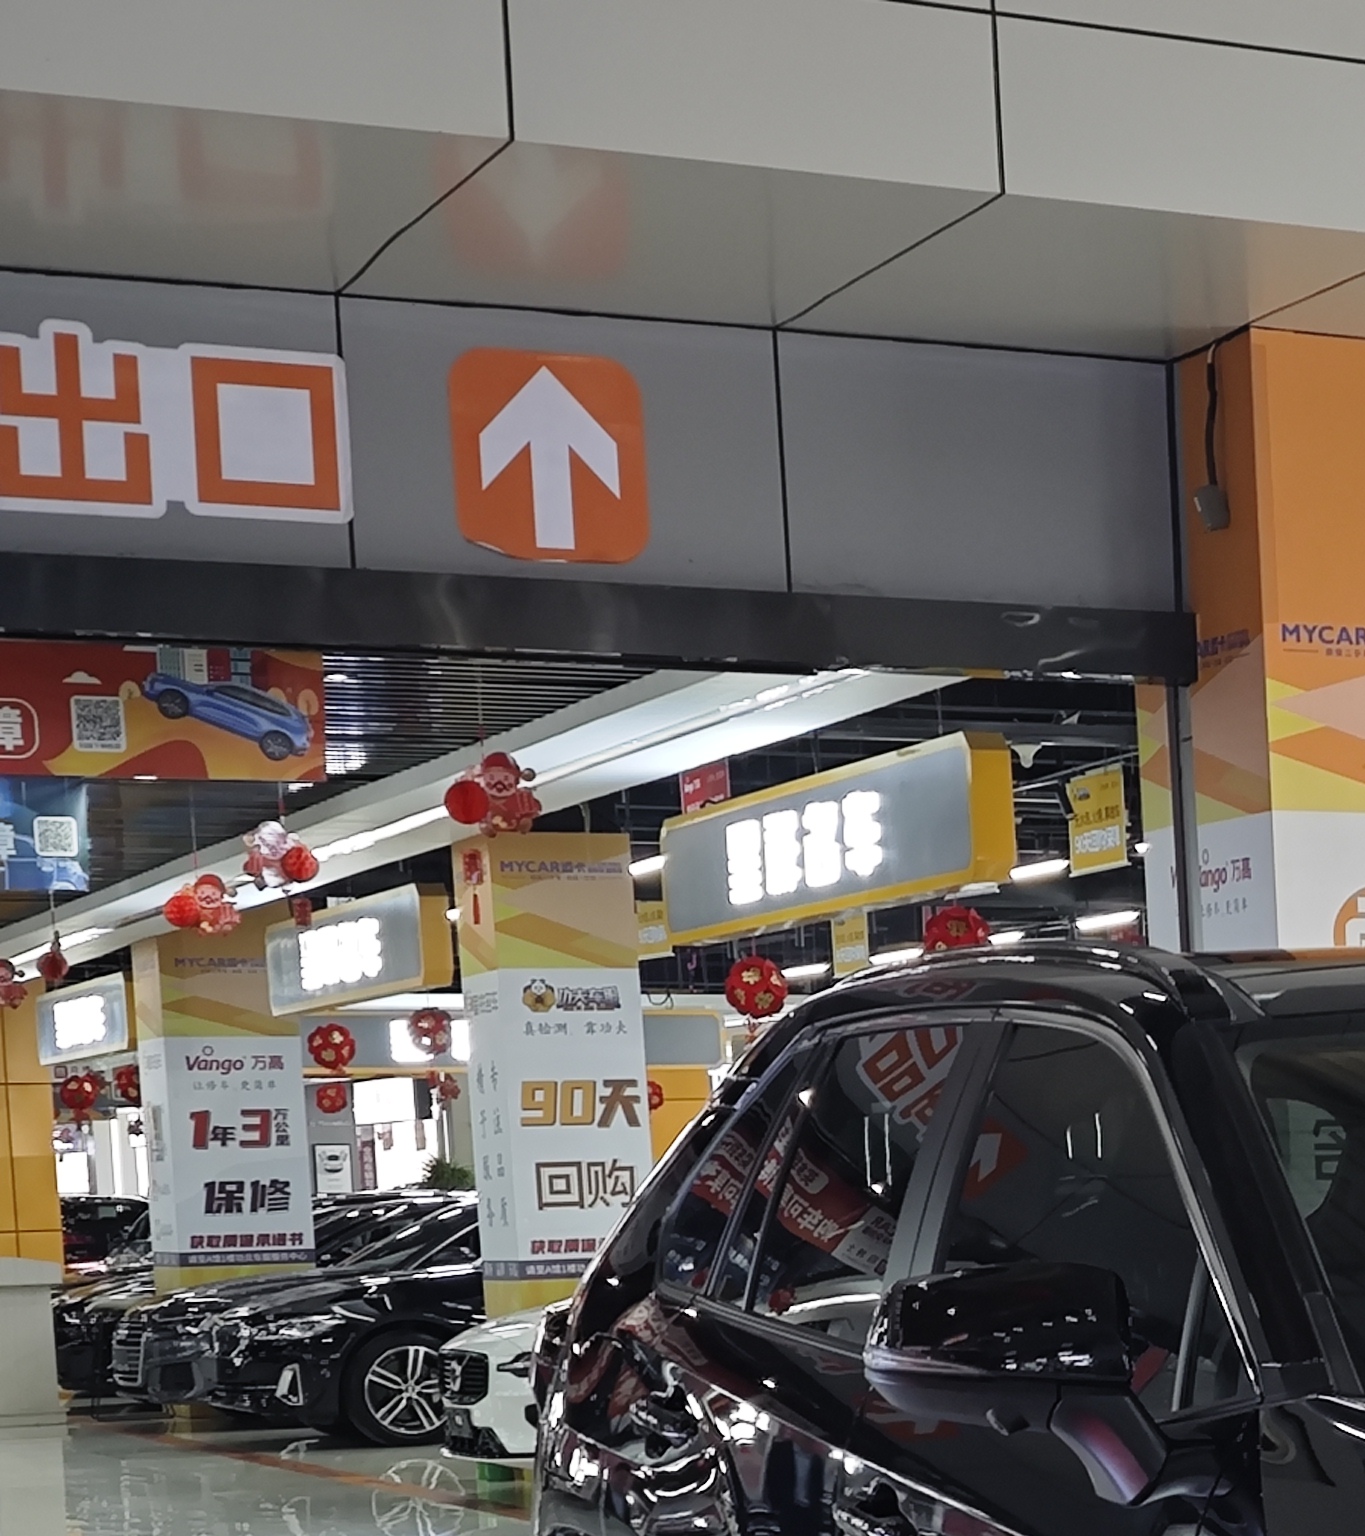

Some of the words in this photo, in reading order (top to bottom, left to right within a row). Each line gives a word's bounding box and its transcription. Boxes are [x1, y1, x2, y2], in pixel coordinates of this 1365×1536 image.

[0, 332, 341, 511] 出口
[185, 1050, 244, 1075] Vango
[251, 1055, 285, 1071] 万高
[520, 1079, 641, 1128] 90天
[203, 1178, 292, 1215] 保修
[535, 1159, 637, 1210] 回购
